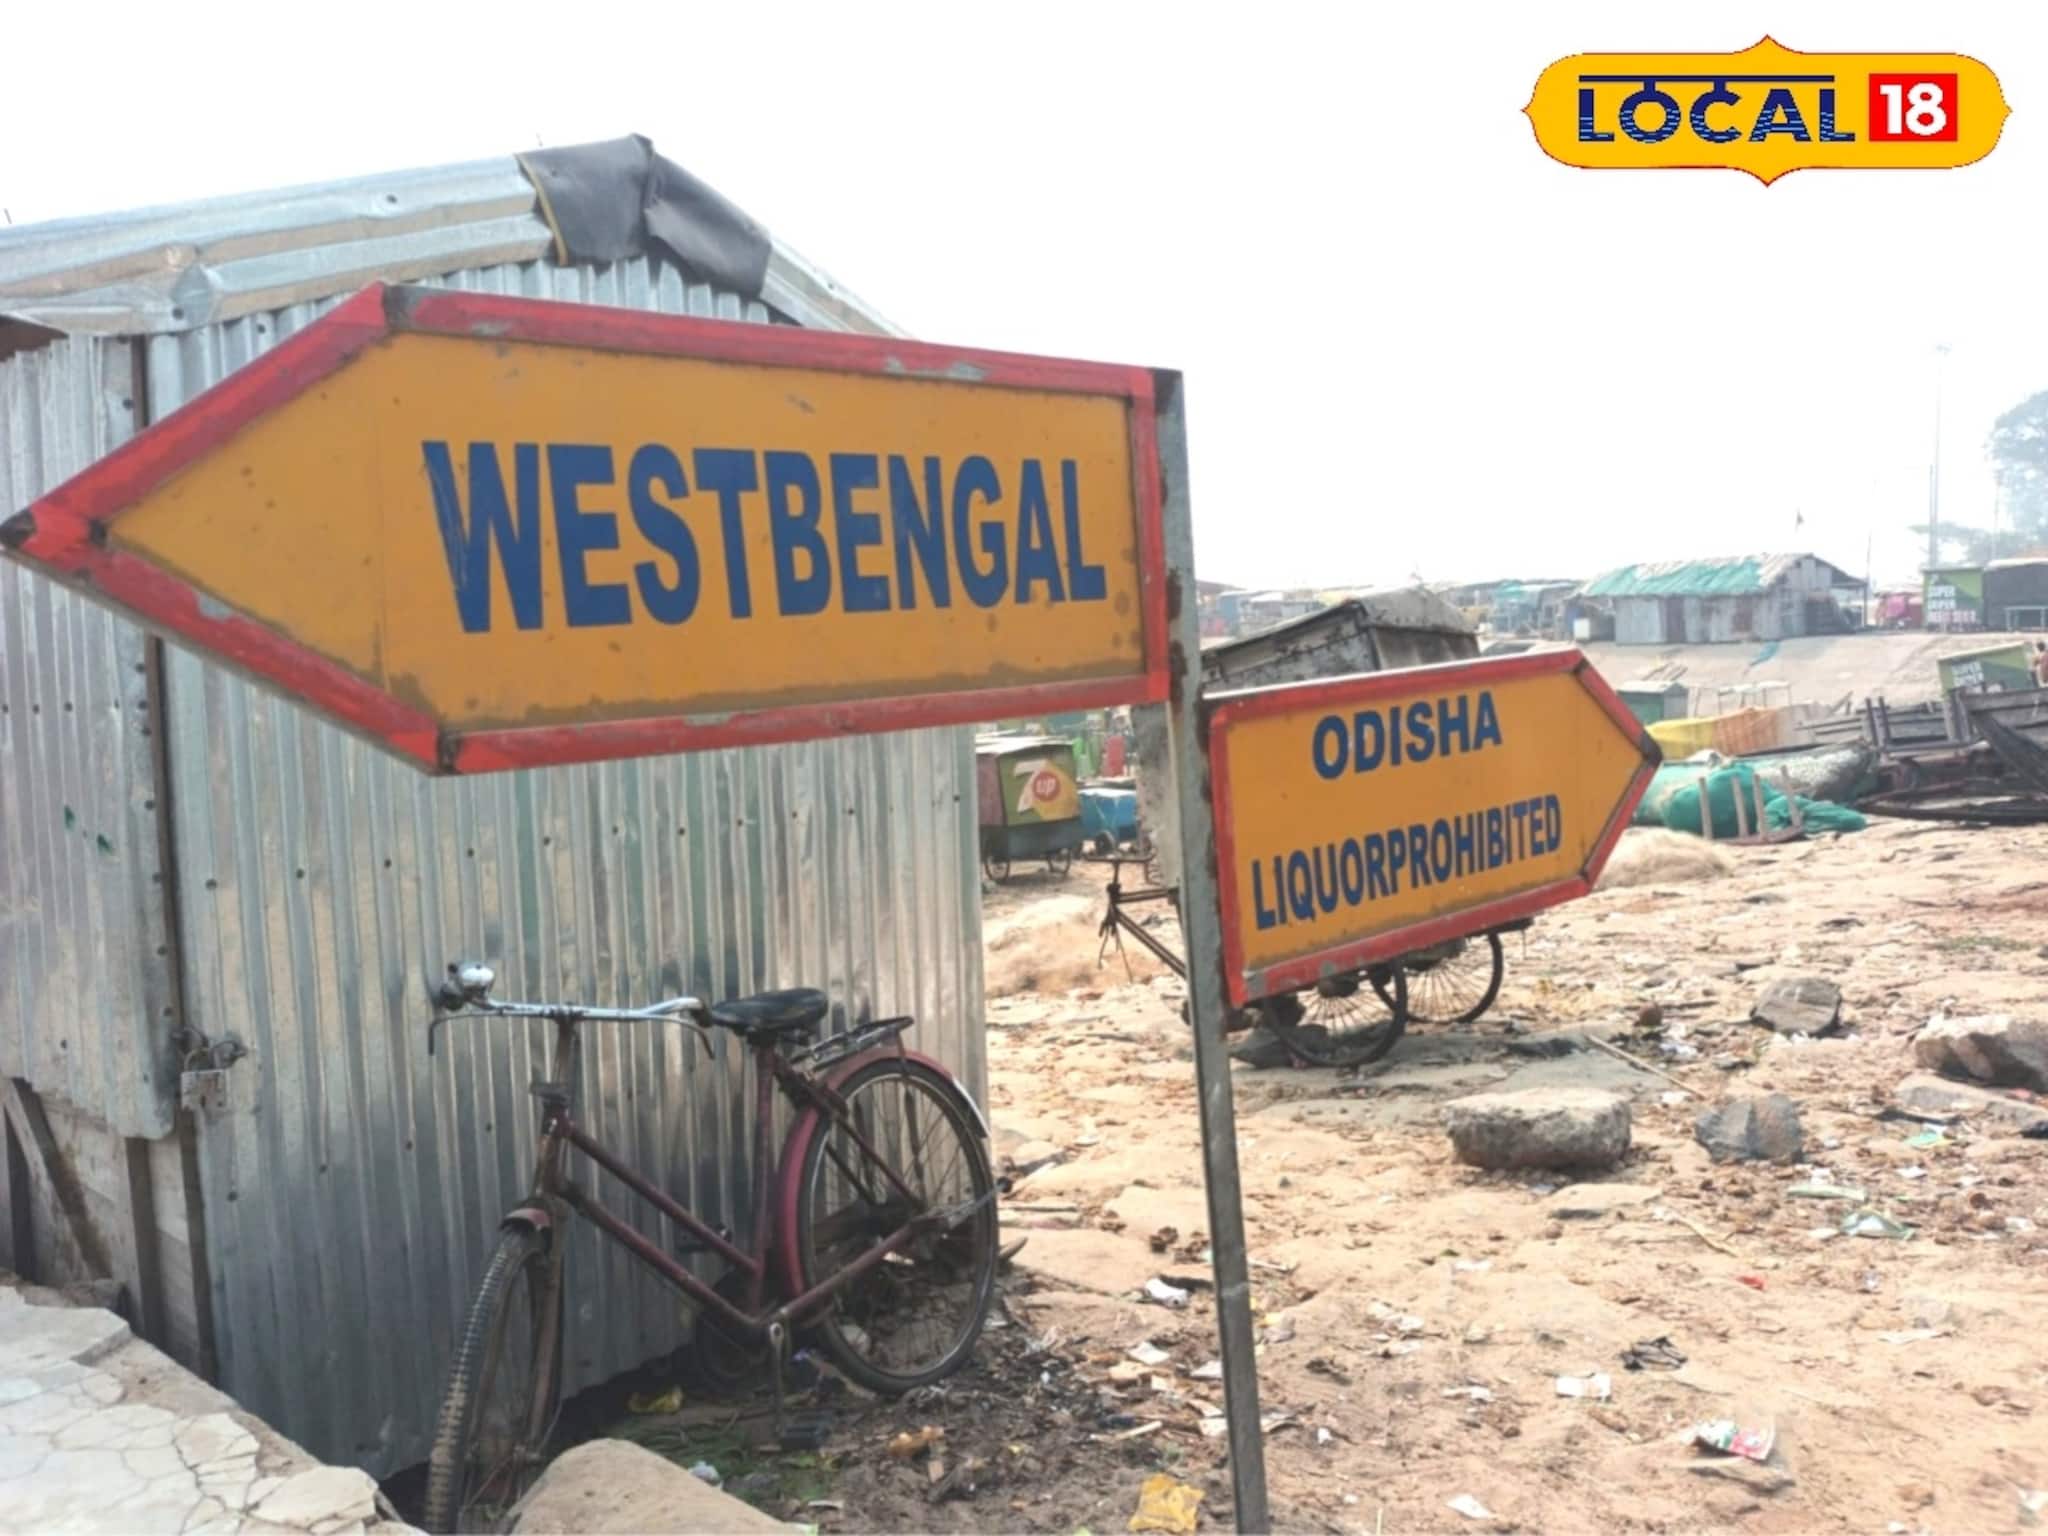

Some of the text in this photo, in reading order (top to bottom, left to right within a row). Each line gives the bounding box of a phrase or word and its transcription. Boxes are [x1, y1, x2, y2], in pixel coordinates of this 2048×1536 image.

[422, 440, 1107, 633] WESTBENGAL
[1313, 691, 1502, 780] ODISHA
[1252, 794, 1561, 930] LIQUORPROHIBITED
